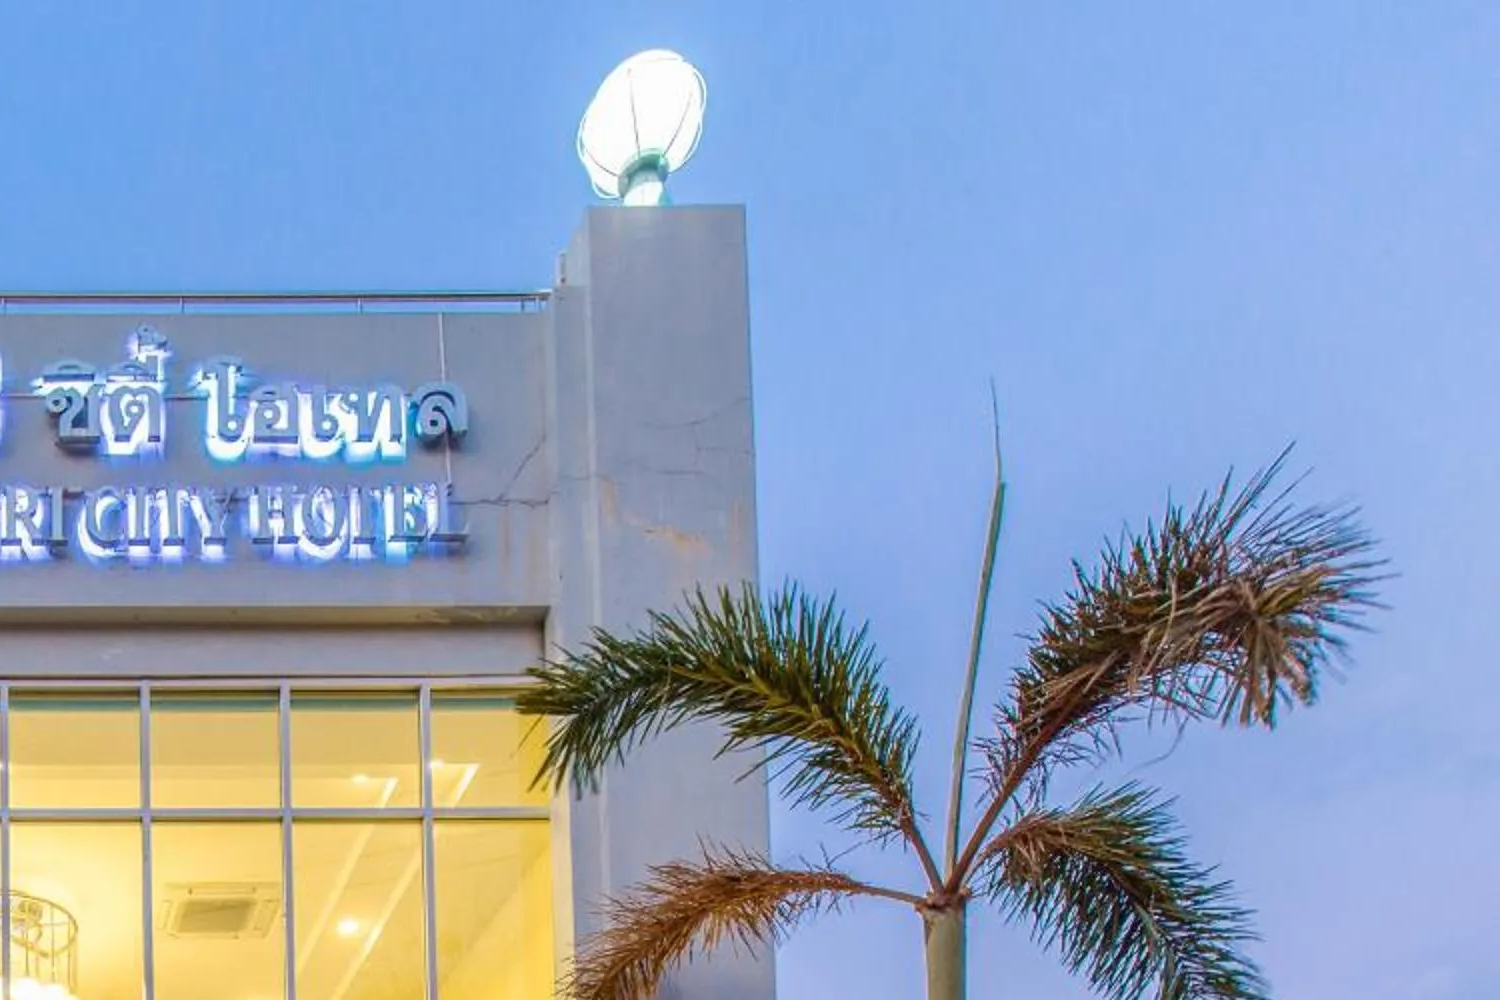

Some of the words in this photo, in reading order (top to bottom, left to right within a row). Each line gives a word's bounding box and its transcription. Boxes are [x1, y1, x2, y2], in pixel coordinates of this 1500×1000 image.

[200, 354, 468, 448] โฮเทล
[81, 484, 233, 552] CITY
[250, 482, 468, 550] HOTEL
